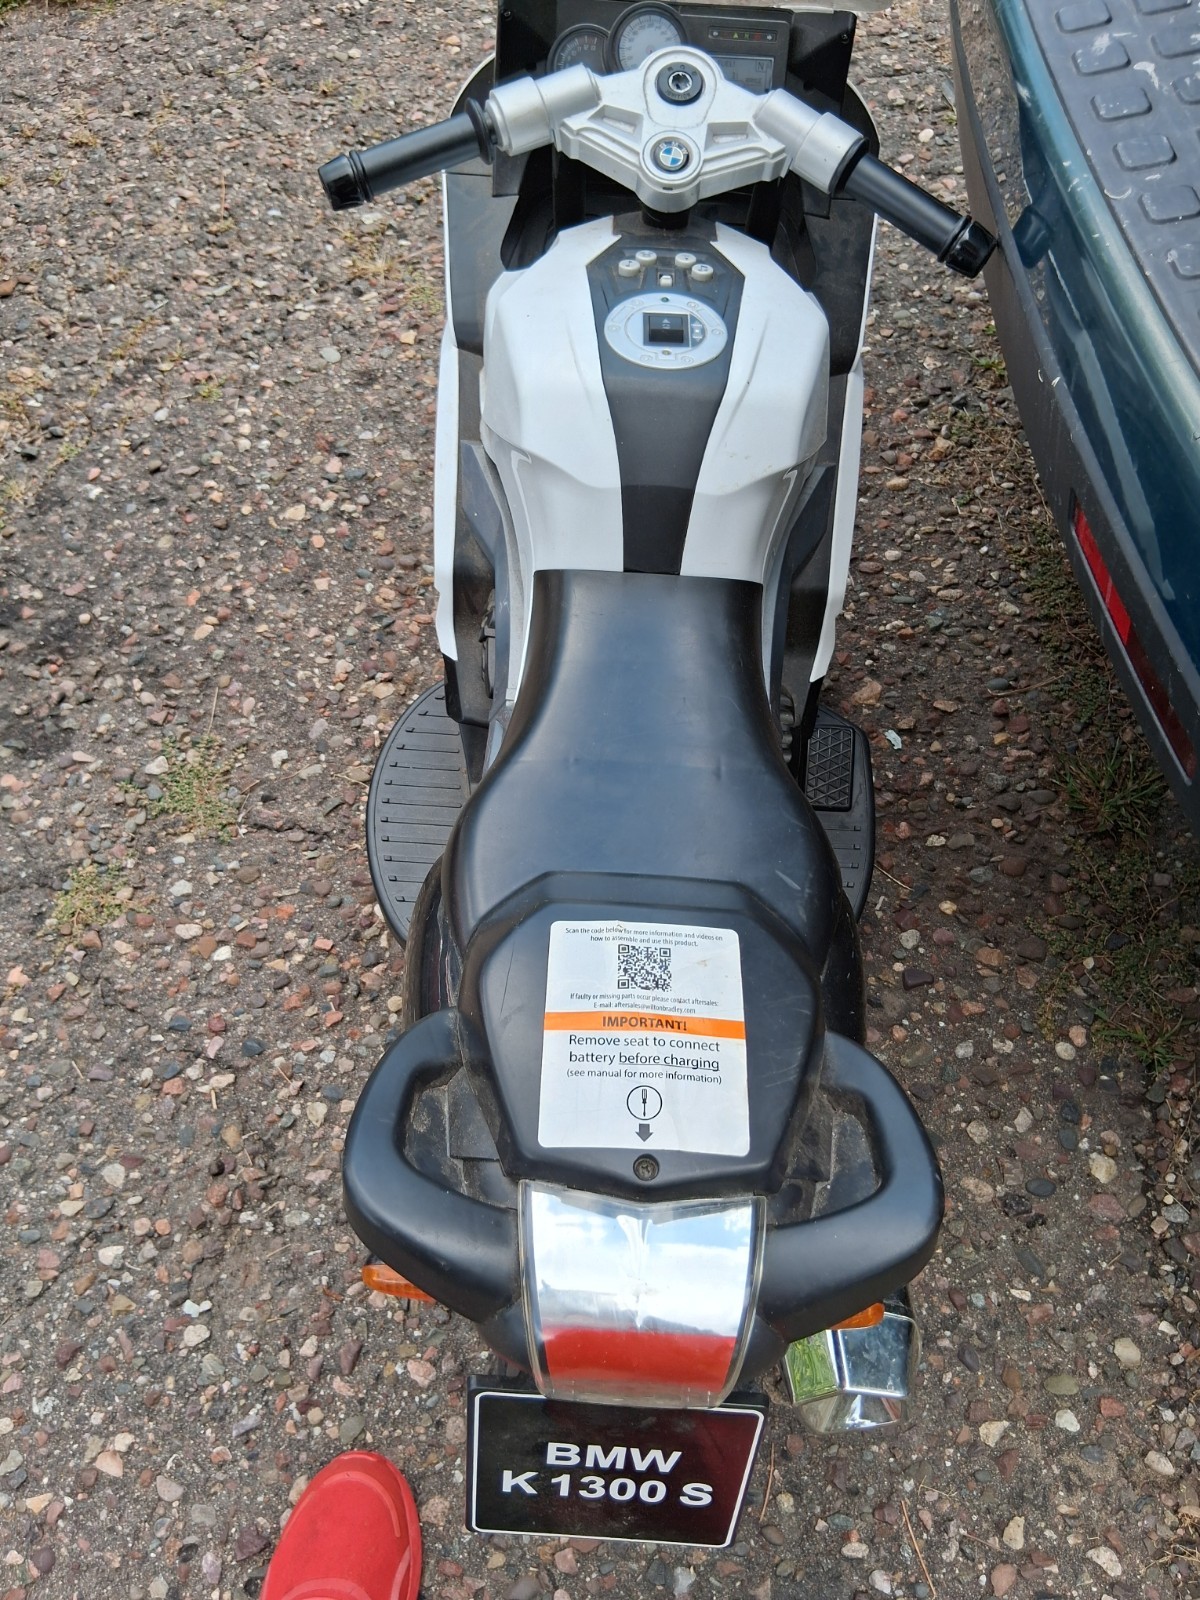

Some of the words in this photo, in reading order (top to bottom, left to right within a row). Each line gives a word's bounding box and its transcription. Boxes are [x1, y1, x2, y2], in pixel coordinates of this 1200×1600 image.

[605, 926, 623, 934] below
[649, 930, 683, 938] information
[696, 933, 714, 941] videos
[575, 993, 591, 1001] faulty
[600, 993, 620, 1001] missing
[602, 1016, 687, 1031] IMPORTANT!
[569, 1034, 620, 1046] Remove
[624, 1036, 649, 1047] seat
[653, 1038, 666, 1047] to
[669, 1039, 720, 1052] connect
[569, 1051, 616, 1065] battery
[619, 1052, 660, 1064] before
[663, 1054, 720, 1071] charging
[566, 1069, 585, 1078] (see
[587, 1069, 622, 1078] manual
[624, 1070, 637, 1078] for
[639, 1071, 663, 1079] more
[665, 1071, 722, 1084] information)
[545, 1442, 682, 1473] BMW
[502, 1470, 538, 1494] K
[551, 1474, 667, 1504] 1300
[679, 1482, 713, 1506] S
